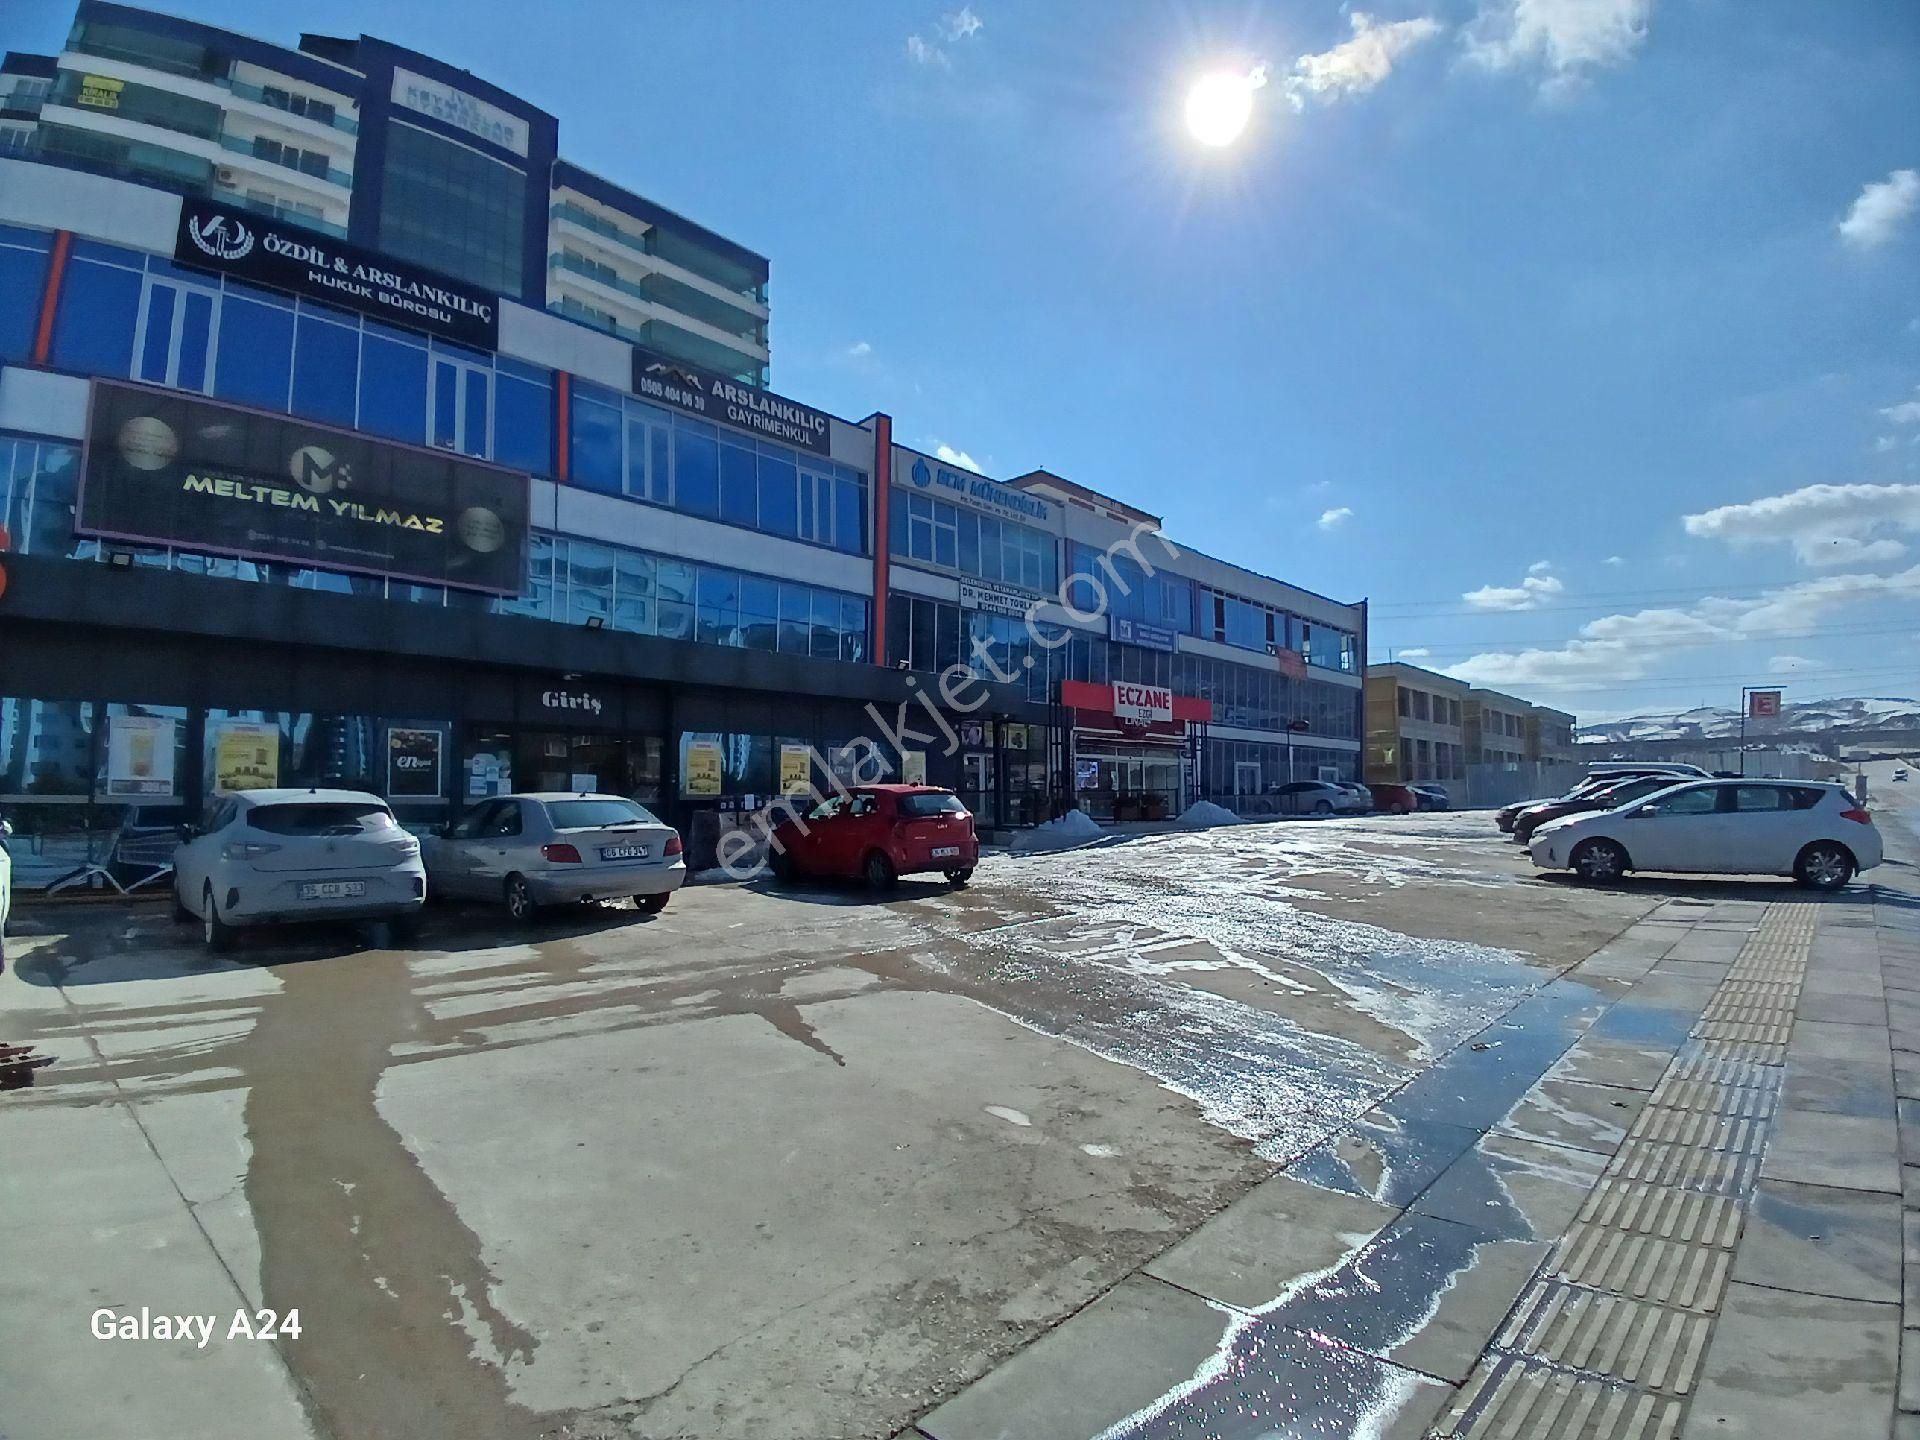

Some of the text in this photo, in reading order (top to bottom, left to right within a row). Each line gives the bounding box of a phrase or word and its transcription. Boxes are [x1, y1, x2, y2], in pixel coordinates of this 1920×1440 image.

[262, 232, 491, 324] ÖZDİL & ARSLANKILIÇ
[308, 270, 452, 323] HUKUK BÜROSU
[711, 380, 825, 436] ARSLANKILIÇ
[727, 405, 813, 446] GAYRİMENKUL
[182, 474, 320, 513] MELTEM
[327, 499, 444, 534] YILMAZ
[542, 691, 602, 715] Giriş
[1117, 685, 1170, 710] ECZANE
